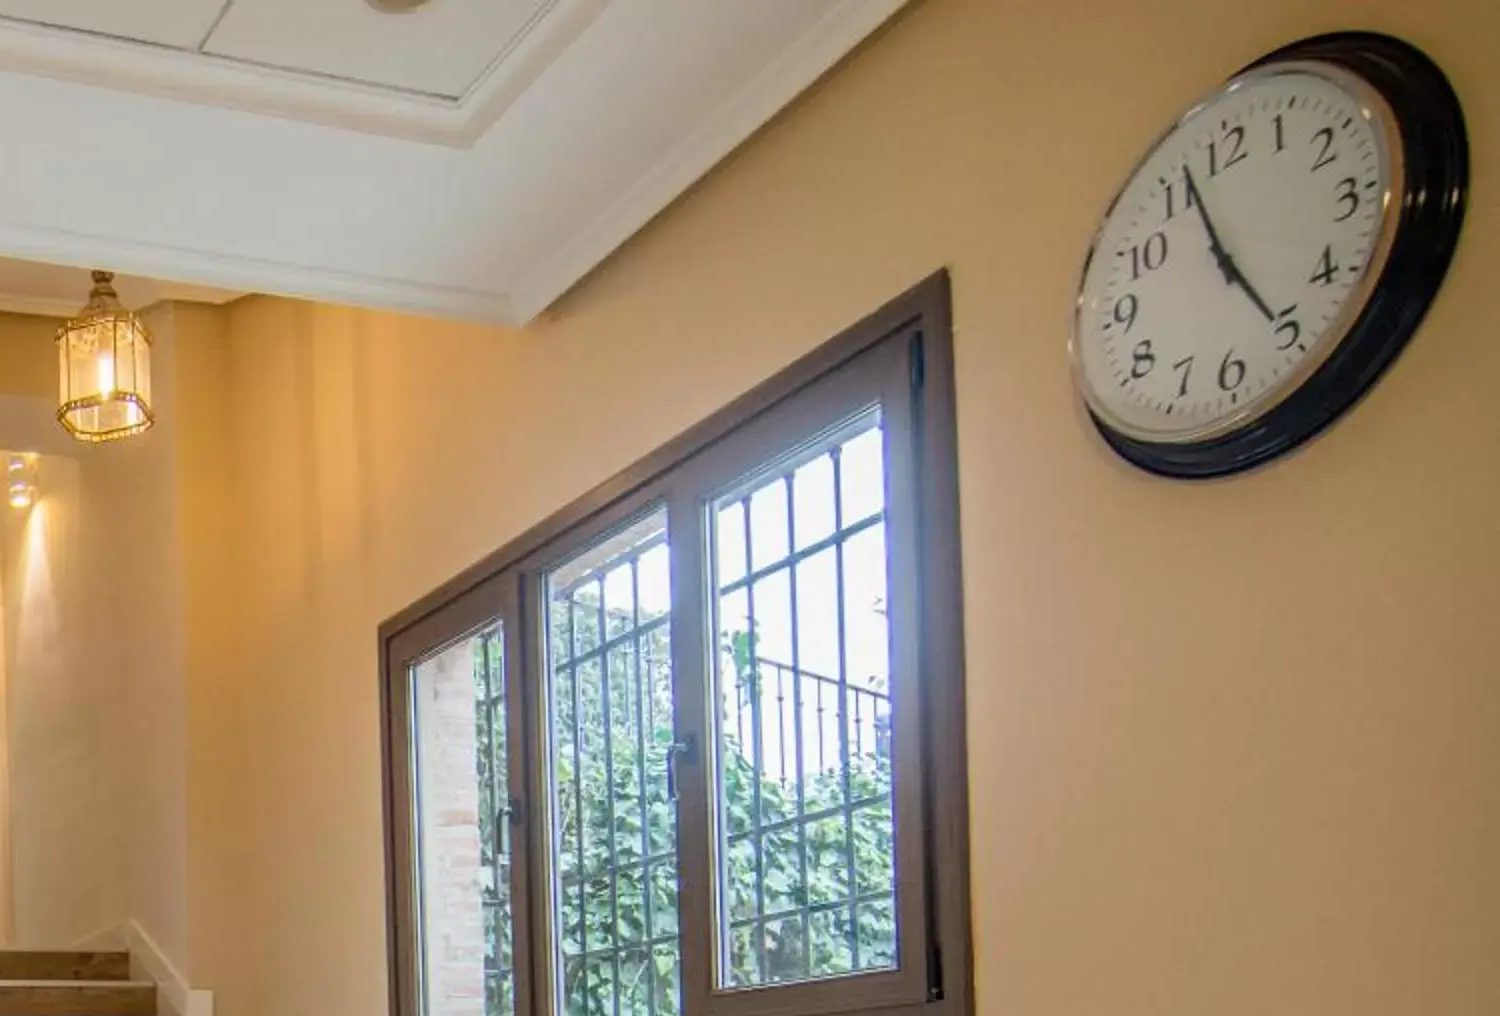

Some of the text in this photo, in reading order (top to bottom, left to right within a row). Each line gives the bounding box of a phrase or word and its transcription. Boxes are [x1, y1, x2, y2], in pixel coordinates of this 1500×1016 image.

[1206, 125, 1248, 177] 12
[1271, 114, 1285, 153] 1
[1310, 127, 1337, 171] 2
[1162, 179, 1196, 220] 11
[1334, 178, 1360, 221] 3
[1126, 232, 1168, 280] 10
[1308, 245, 1339, 287] 4
[1113, 294, 1138, 335] 9
[1274, 304, 1300, 350] 5
[1130, 339, 1156, 380] 8
[1173, 356, 1194, 398] 7
[1218, 349, 1246, 392] 6
